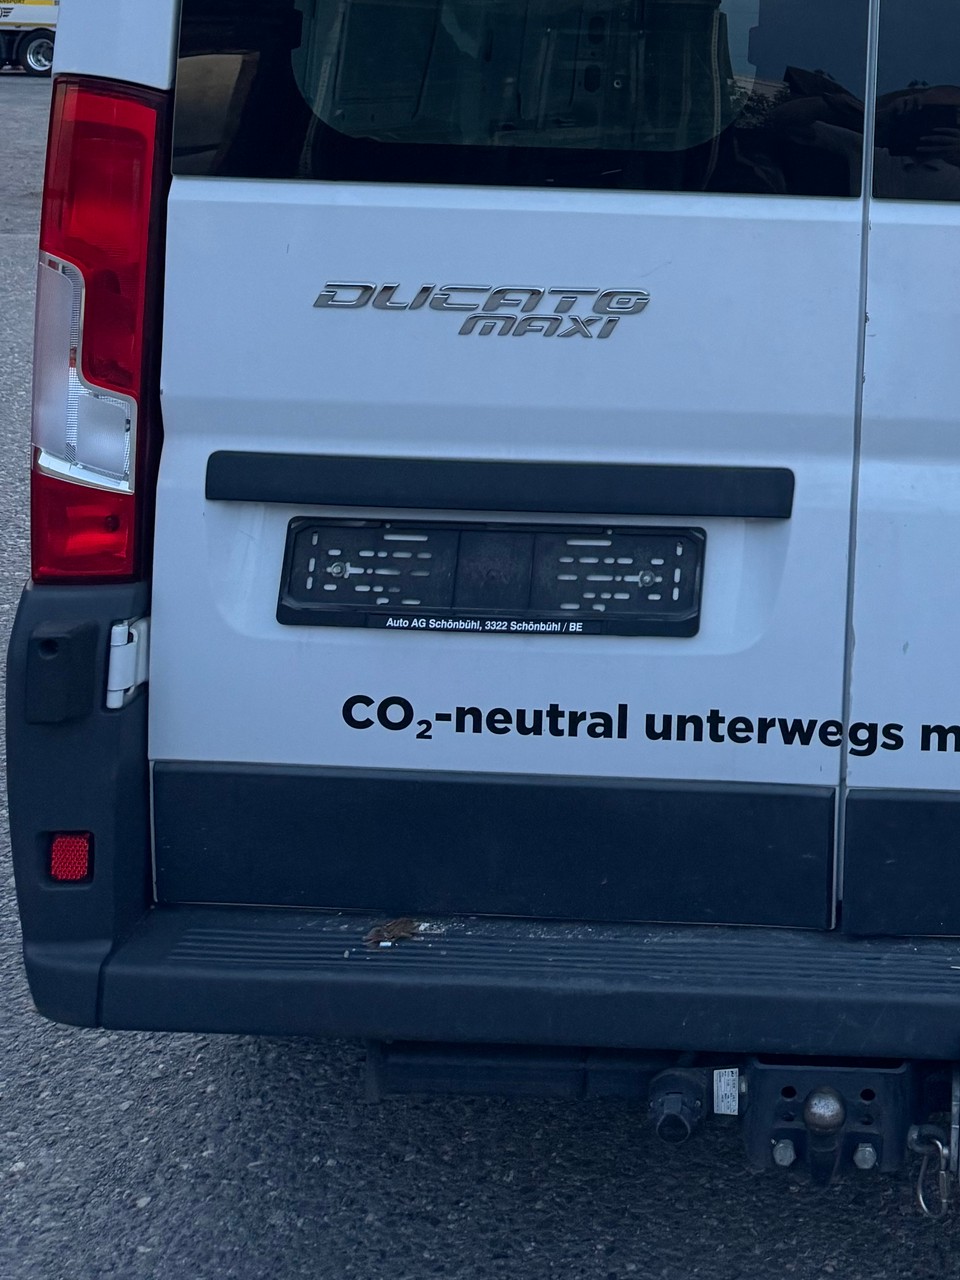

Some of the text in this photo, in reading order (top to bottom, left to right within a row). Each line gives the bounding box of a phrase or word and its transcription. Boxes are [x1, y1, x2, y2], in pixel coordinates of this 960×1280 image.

[313, 281, 650, 315] DUCATO
[458, 312, 620, 339] MAXI
[386, 617, 409, 628] Auto
[411, 618, 427, 628] AG
[428, 618, 483, 631] Schönbühl,
[484, 621, 508, 631] 3322
[510, 621, 561, 632] Schönbühl
[568, 622, 584, 632] BE
[645, 707, 904, 757] unterwegs
